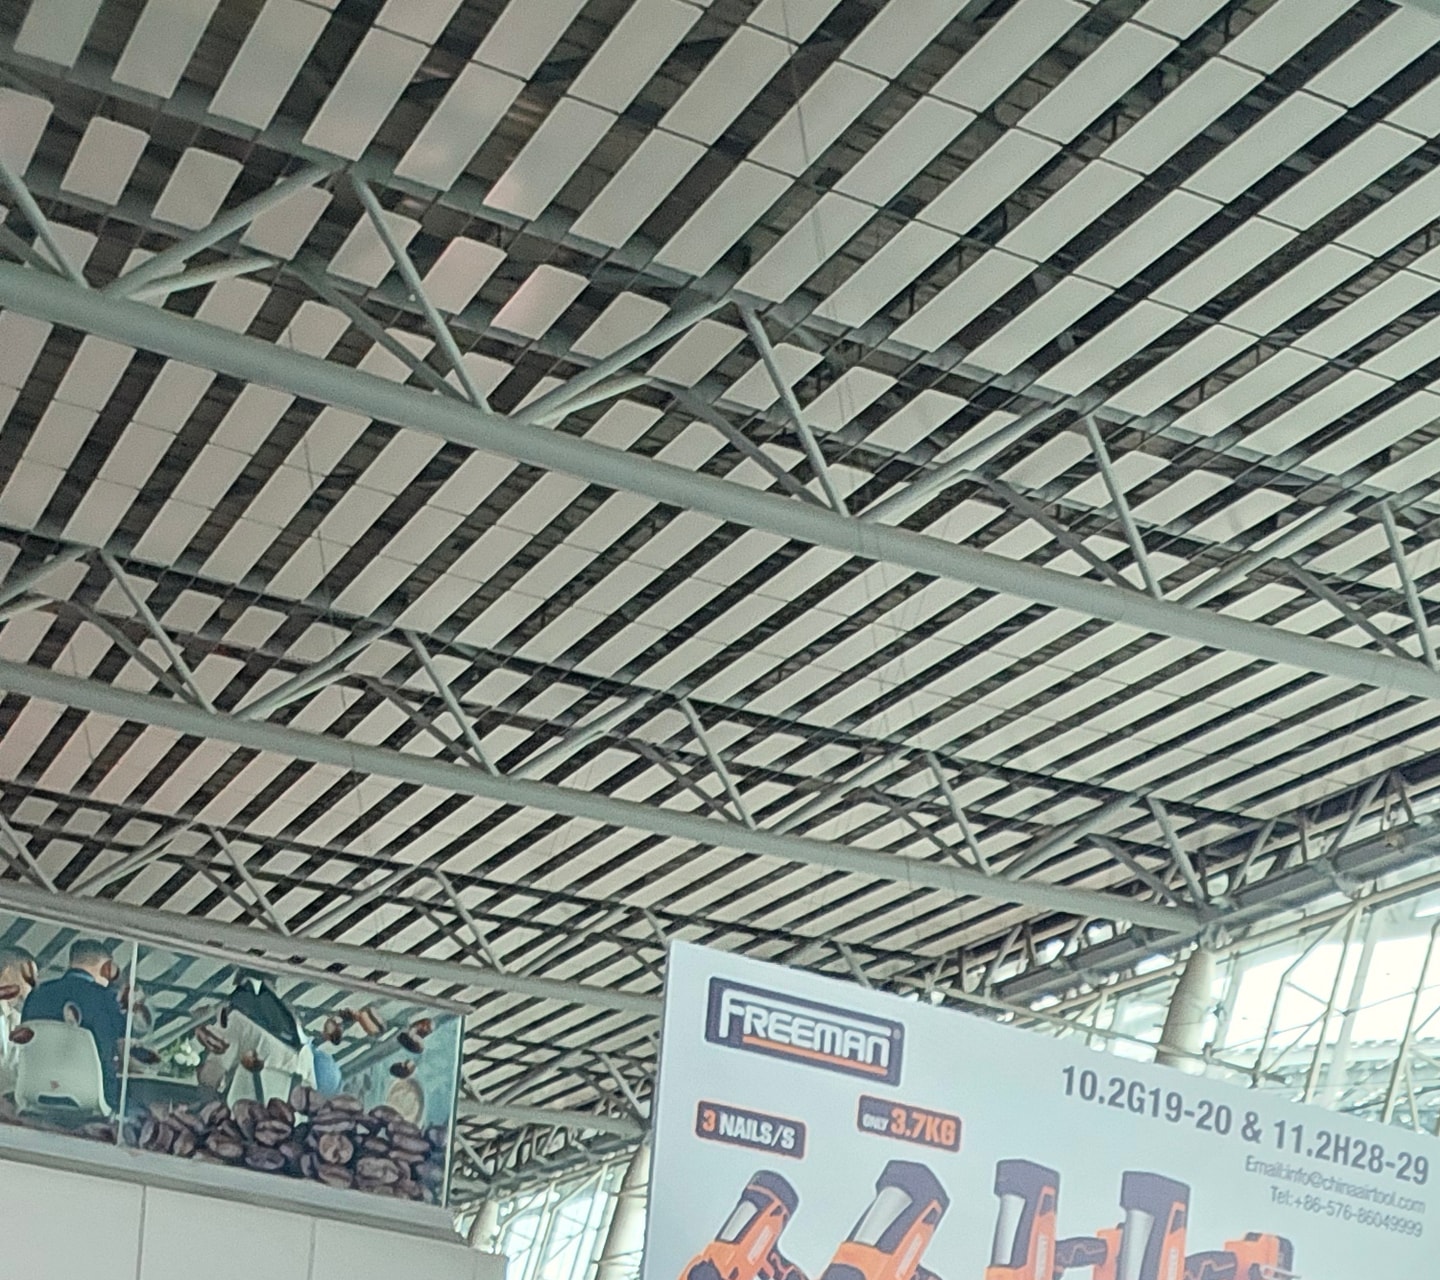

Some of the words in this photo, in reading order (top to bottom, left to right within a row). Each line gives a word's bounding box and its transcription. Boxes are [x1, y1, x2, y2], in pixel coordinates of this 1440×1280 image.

[719, 989, 891, 1067] FREEMAN
[703, 1109, 716, 1132] 3
[719, 1112, 795, 1150] NAILS/S
[862, 1113, 890, 1132] ONLY
[890, 1105, 957, 1146] 3.7KG
[1061, 1065, 1232, 1136] 10.2G19-20
[1241, 1111, 1263, 1143] &
[1274, 1119, 1429, 1185] 11.2H28-29
